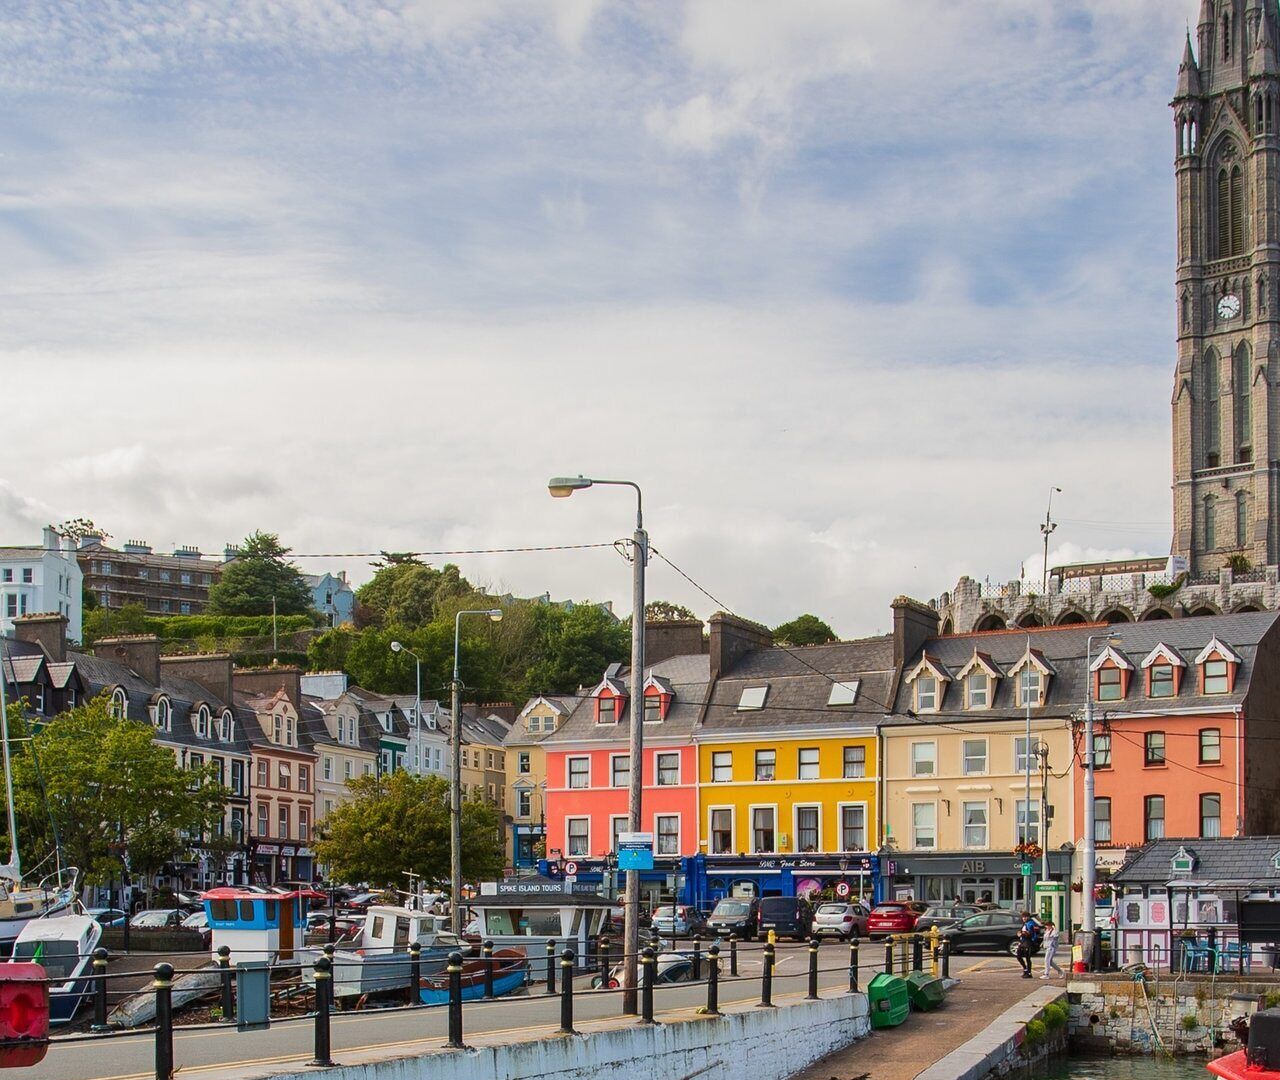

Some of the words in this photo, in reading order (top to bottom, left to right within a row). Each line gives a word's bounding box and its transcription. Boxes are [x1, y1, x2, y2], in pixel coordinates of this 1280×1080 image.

[799, 859, 816, 867] Store
[961, 860, 986, 873] AIB
[542, 884, 561, 892] TOURS
